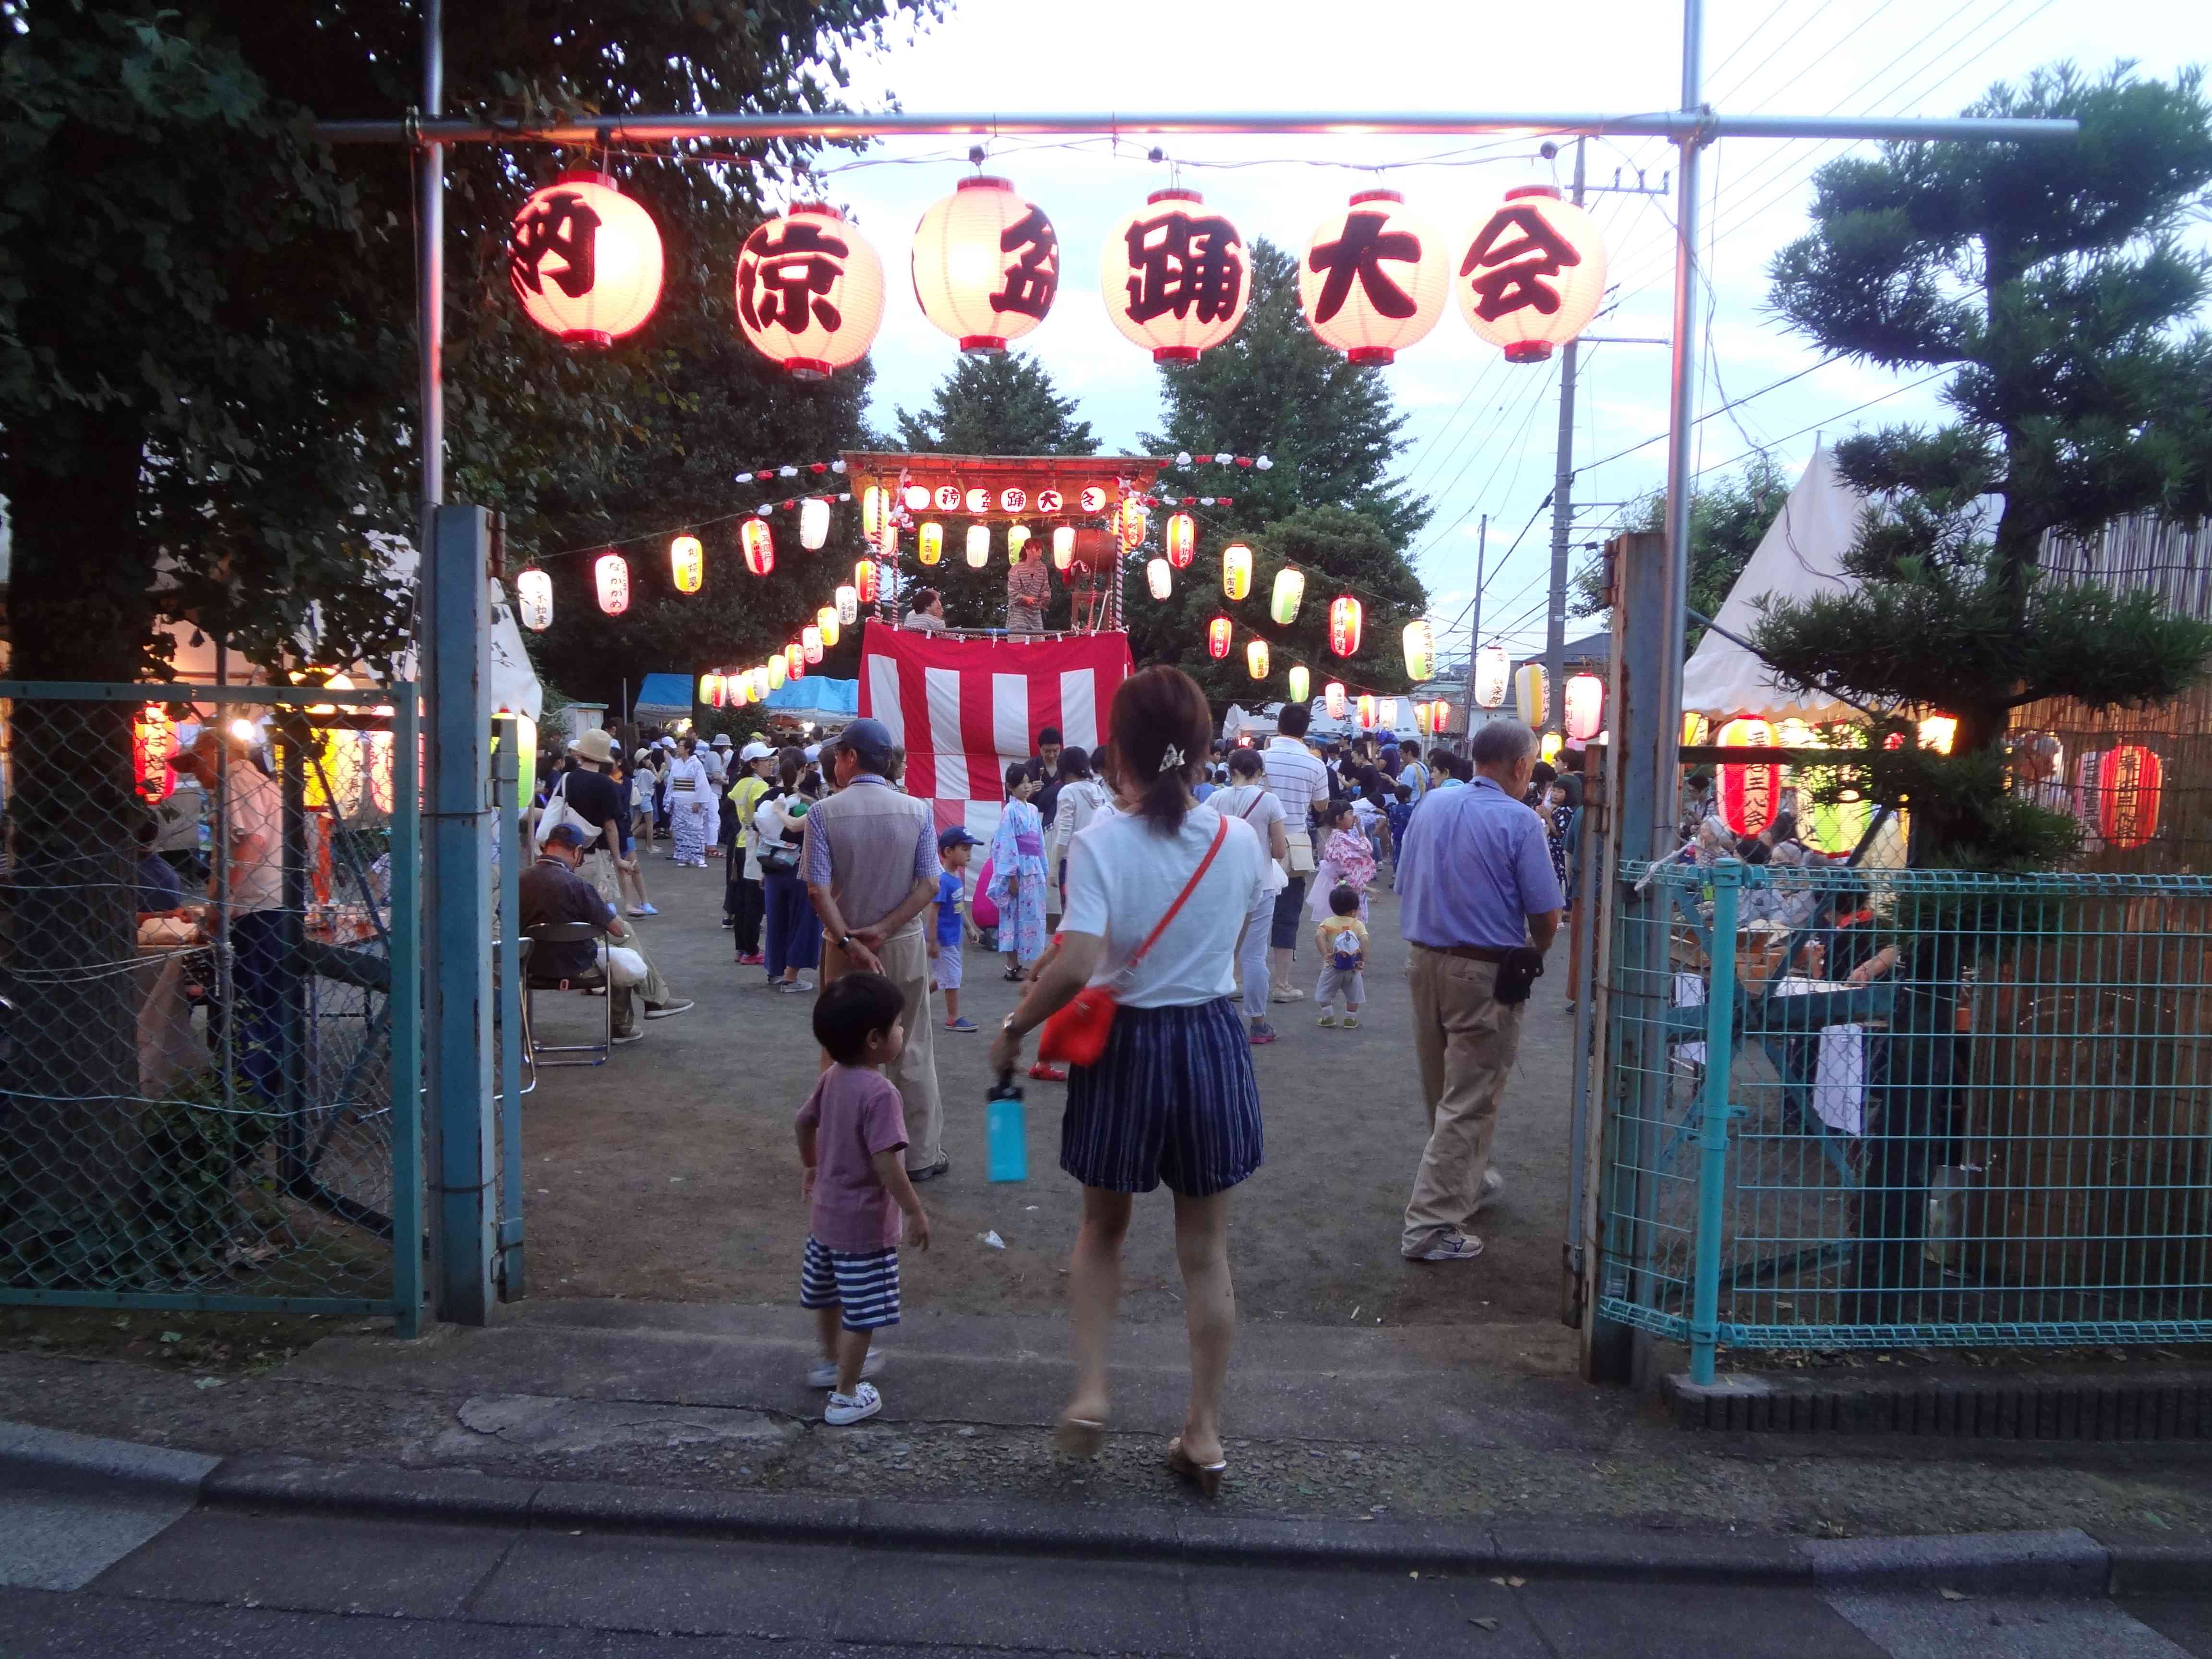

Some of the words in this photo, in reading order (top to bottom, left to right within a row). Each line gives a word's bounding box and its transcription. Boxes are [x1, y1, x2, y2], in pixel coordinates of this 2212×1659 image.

[737, 221, 849, 333] 涼
[1124, 211, 1242, 323] 踊
[1309, 210, 1420, 323] 大
[1460, 204, 1581, 321] 会
[1040, 493, 1058, 508] 大
